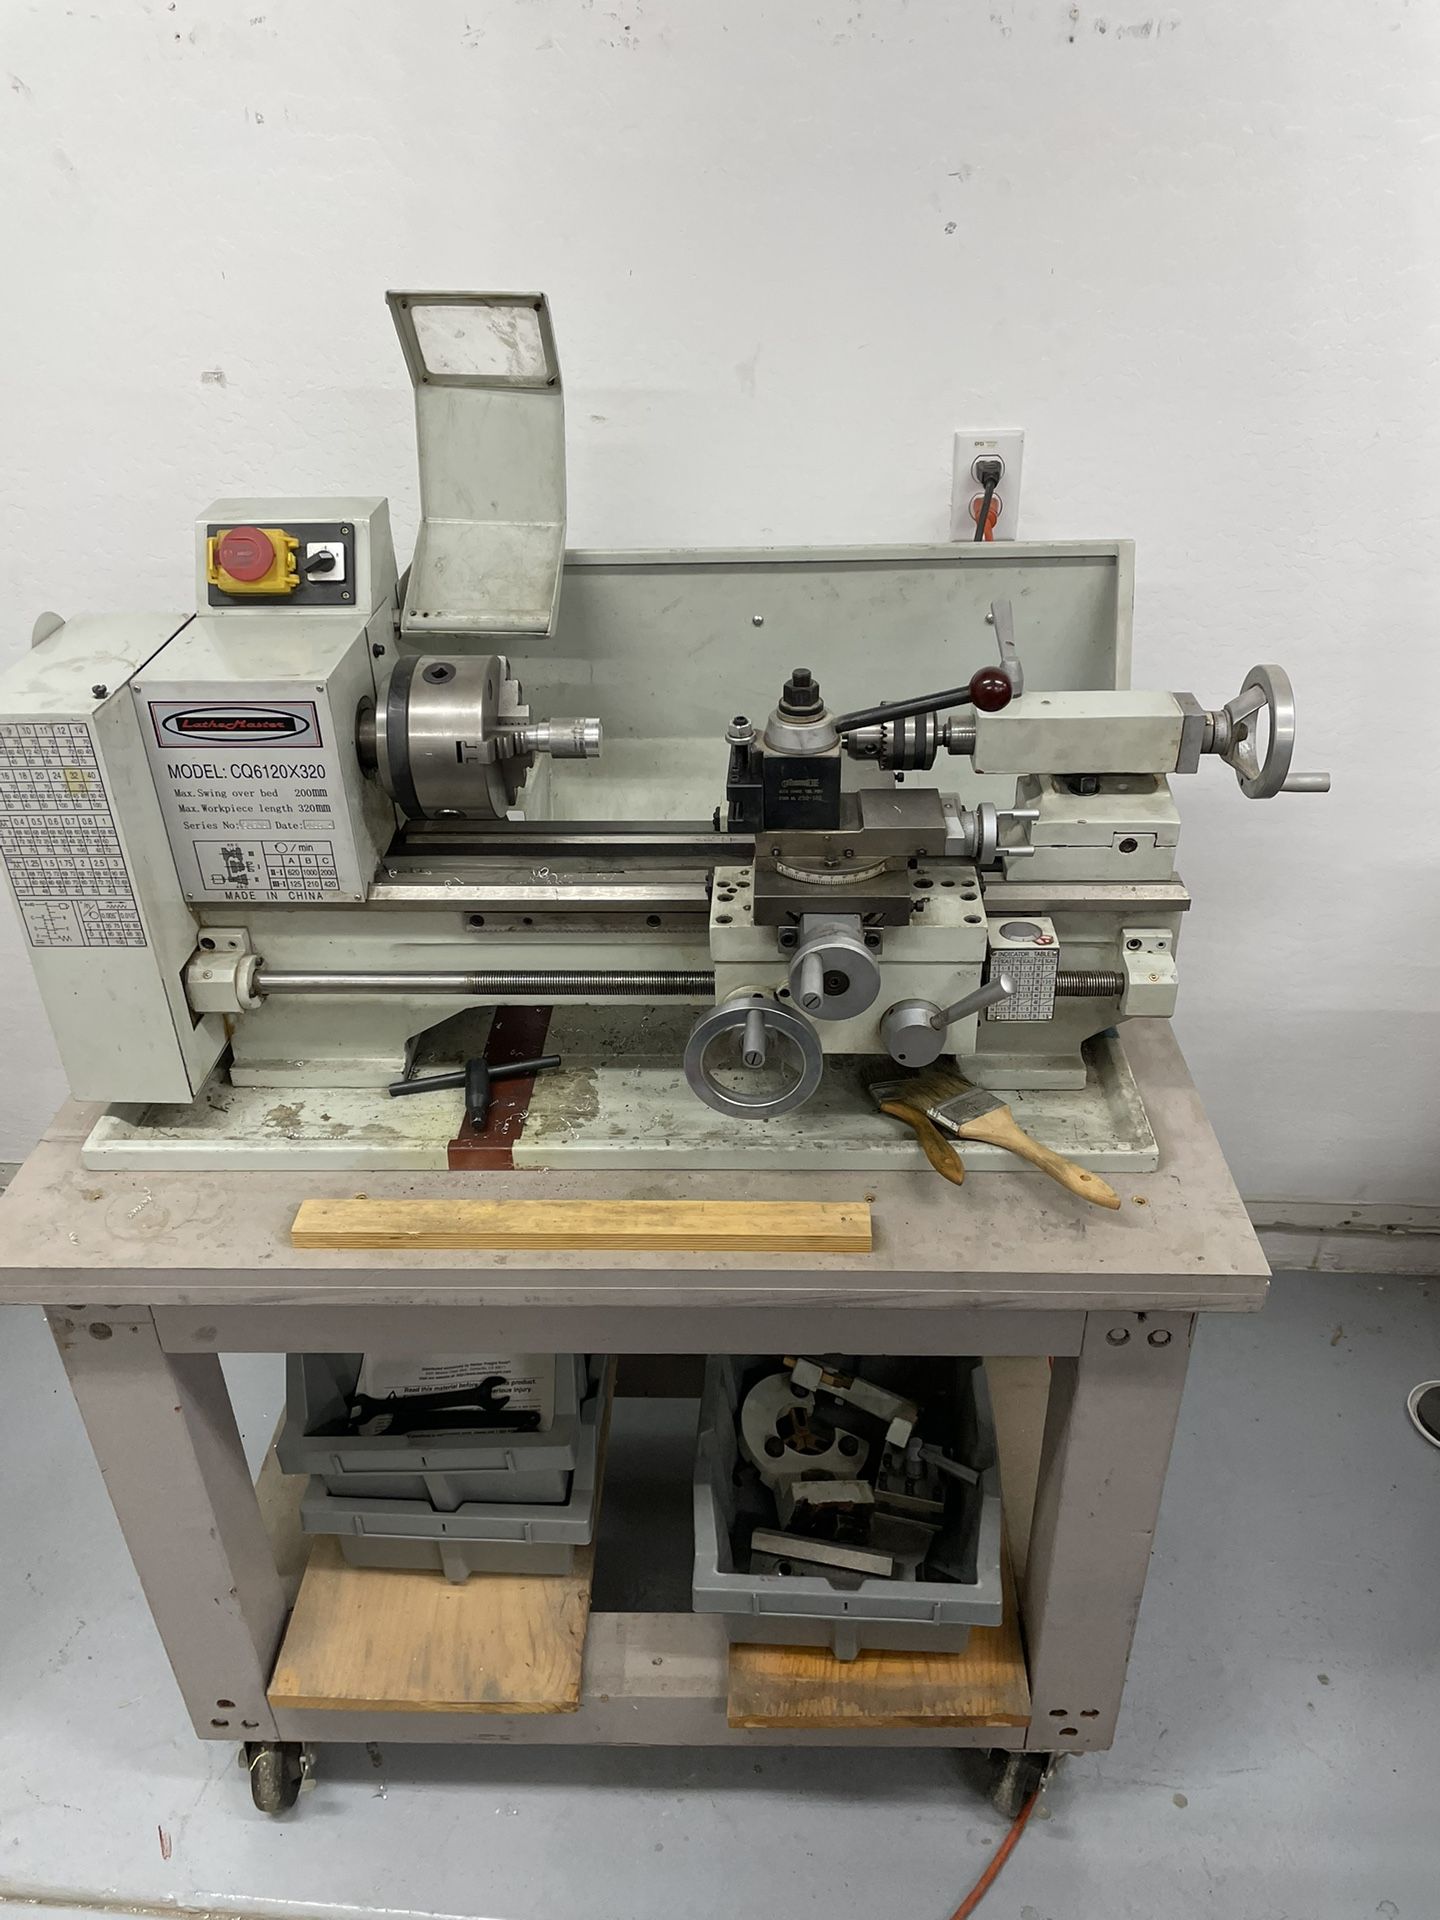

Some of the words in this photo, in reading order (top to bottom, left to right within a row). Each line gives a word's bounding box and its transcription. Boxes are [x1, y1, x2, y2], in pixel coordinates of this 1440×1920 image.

[182, 719, 285, 730] LatheMaster
[57, 727, 66, 735] 12
[167, 764, 227, 779] MODEL:
[230, 763, 326, 779] CQ6120X320
[35, 772, 44, 780] 20
[52, 772, 61, 780] 24
[69, 772, 79, 780] 32
[87, 772, 96, 780] 40
[260, 789, 279, 797] bed
[294, 789, 328, 797] 200mm
[259, 804, 293, 813] length
[298, 804, 332, 812] 320mm
[183, 821, 218, 830] Series
[222, 821, 239, 830] No:
[275, 821, 303, 830] Date:
[225, 891, 256, 900] MADE
[266, 891, 278, 900] IN
[288, 891, 324, 900] CHINA
[434, 1383, 458, 1391] material
